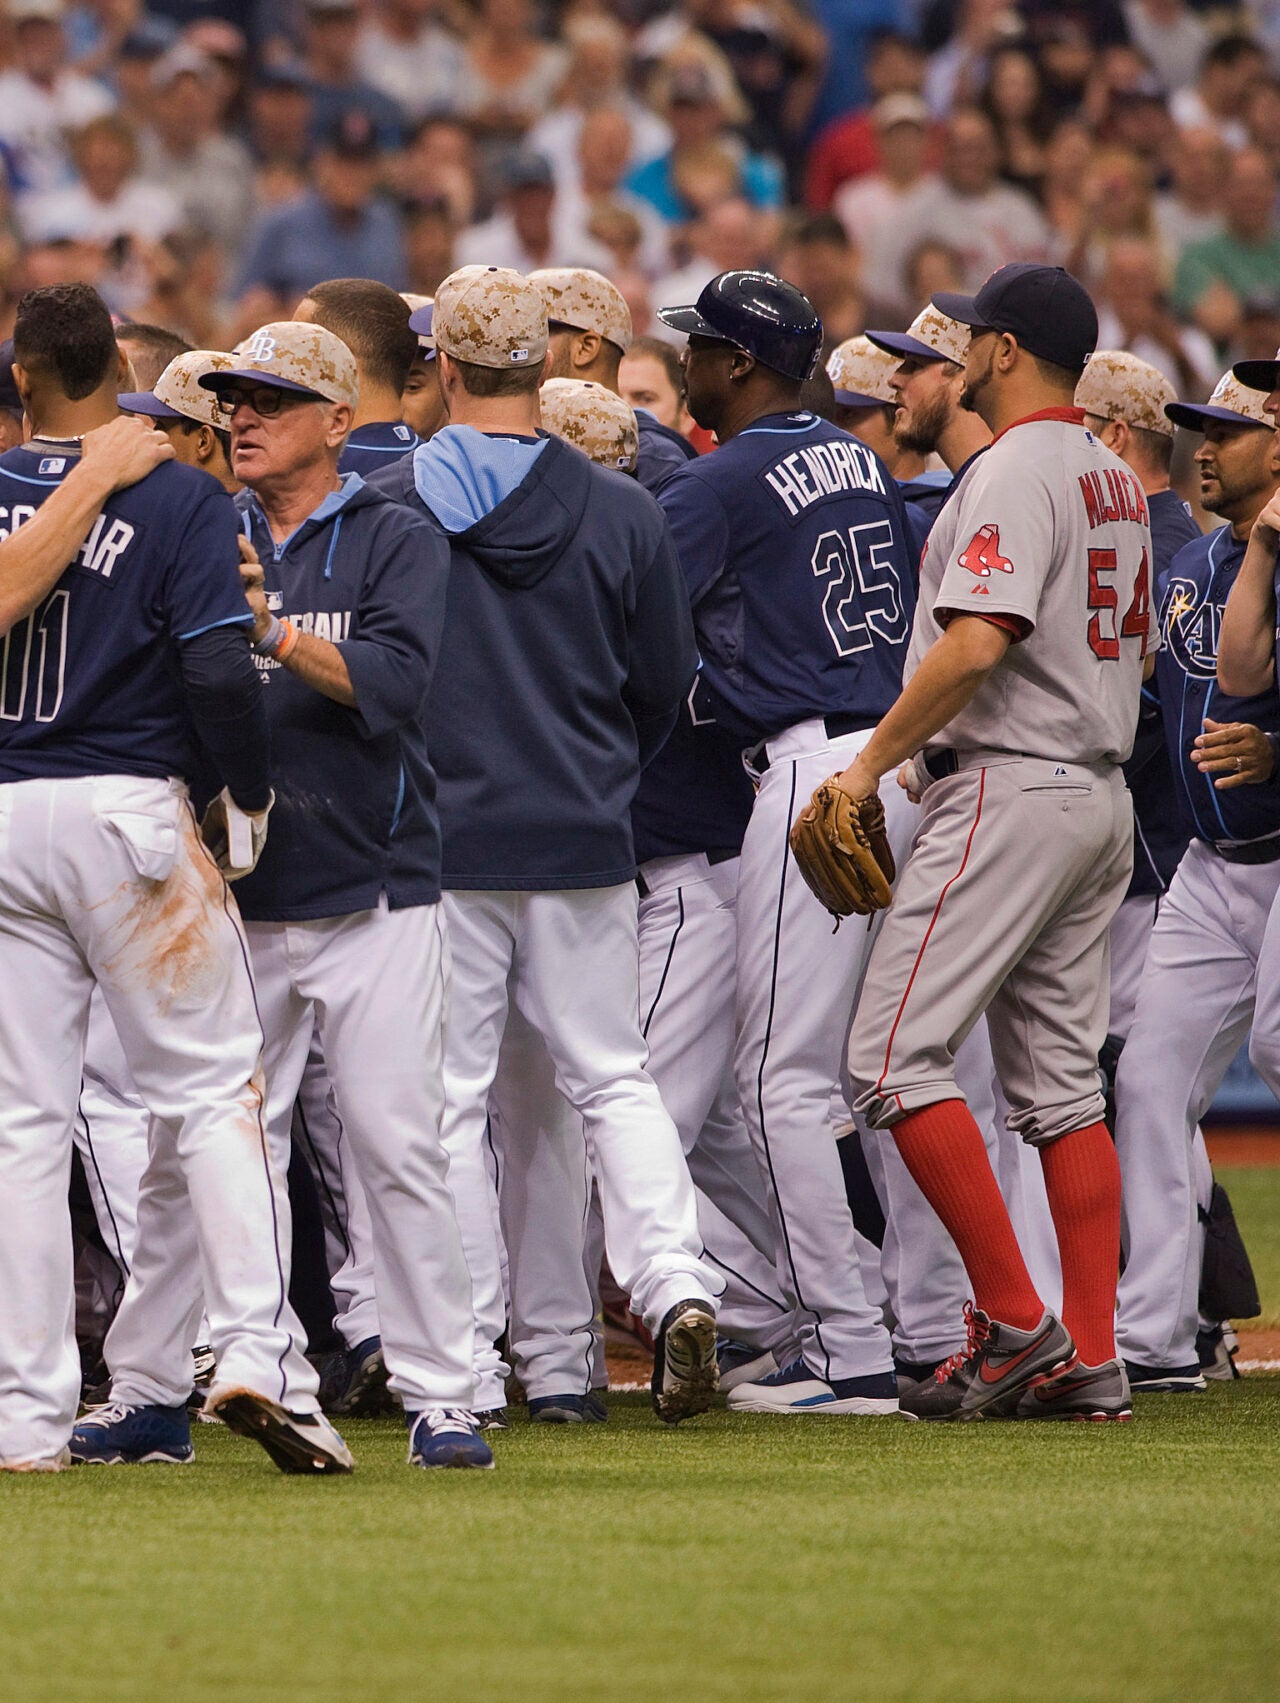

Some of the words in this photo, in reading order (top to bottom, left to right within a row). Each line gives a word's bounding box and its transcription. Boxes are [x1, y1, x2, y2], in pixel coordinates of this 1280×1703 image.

[764, 441, 887, 516] HENDRICK
[811, 519, 910, 657] 25
[1087, 545, 1151, 661] 54
[0, 589, 70, 723] 11
